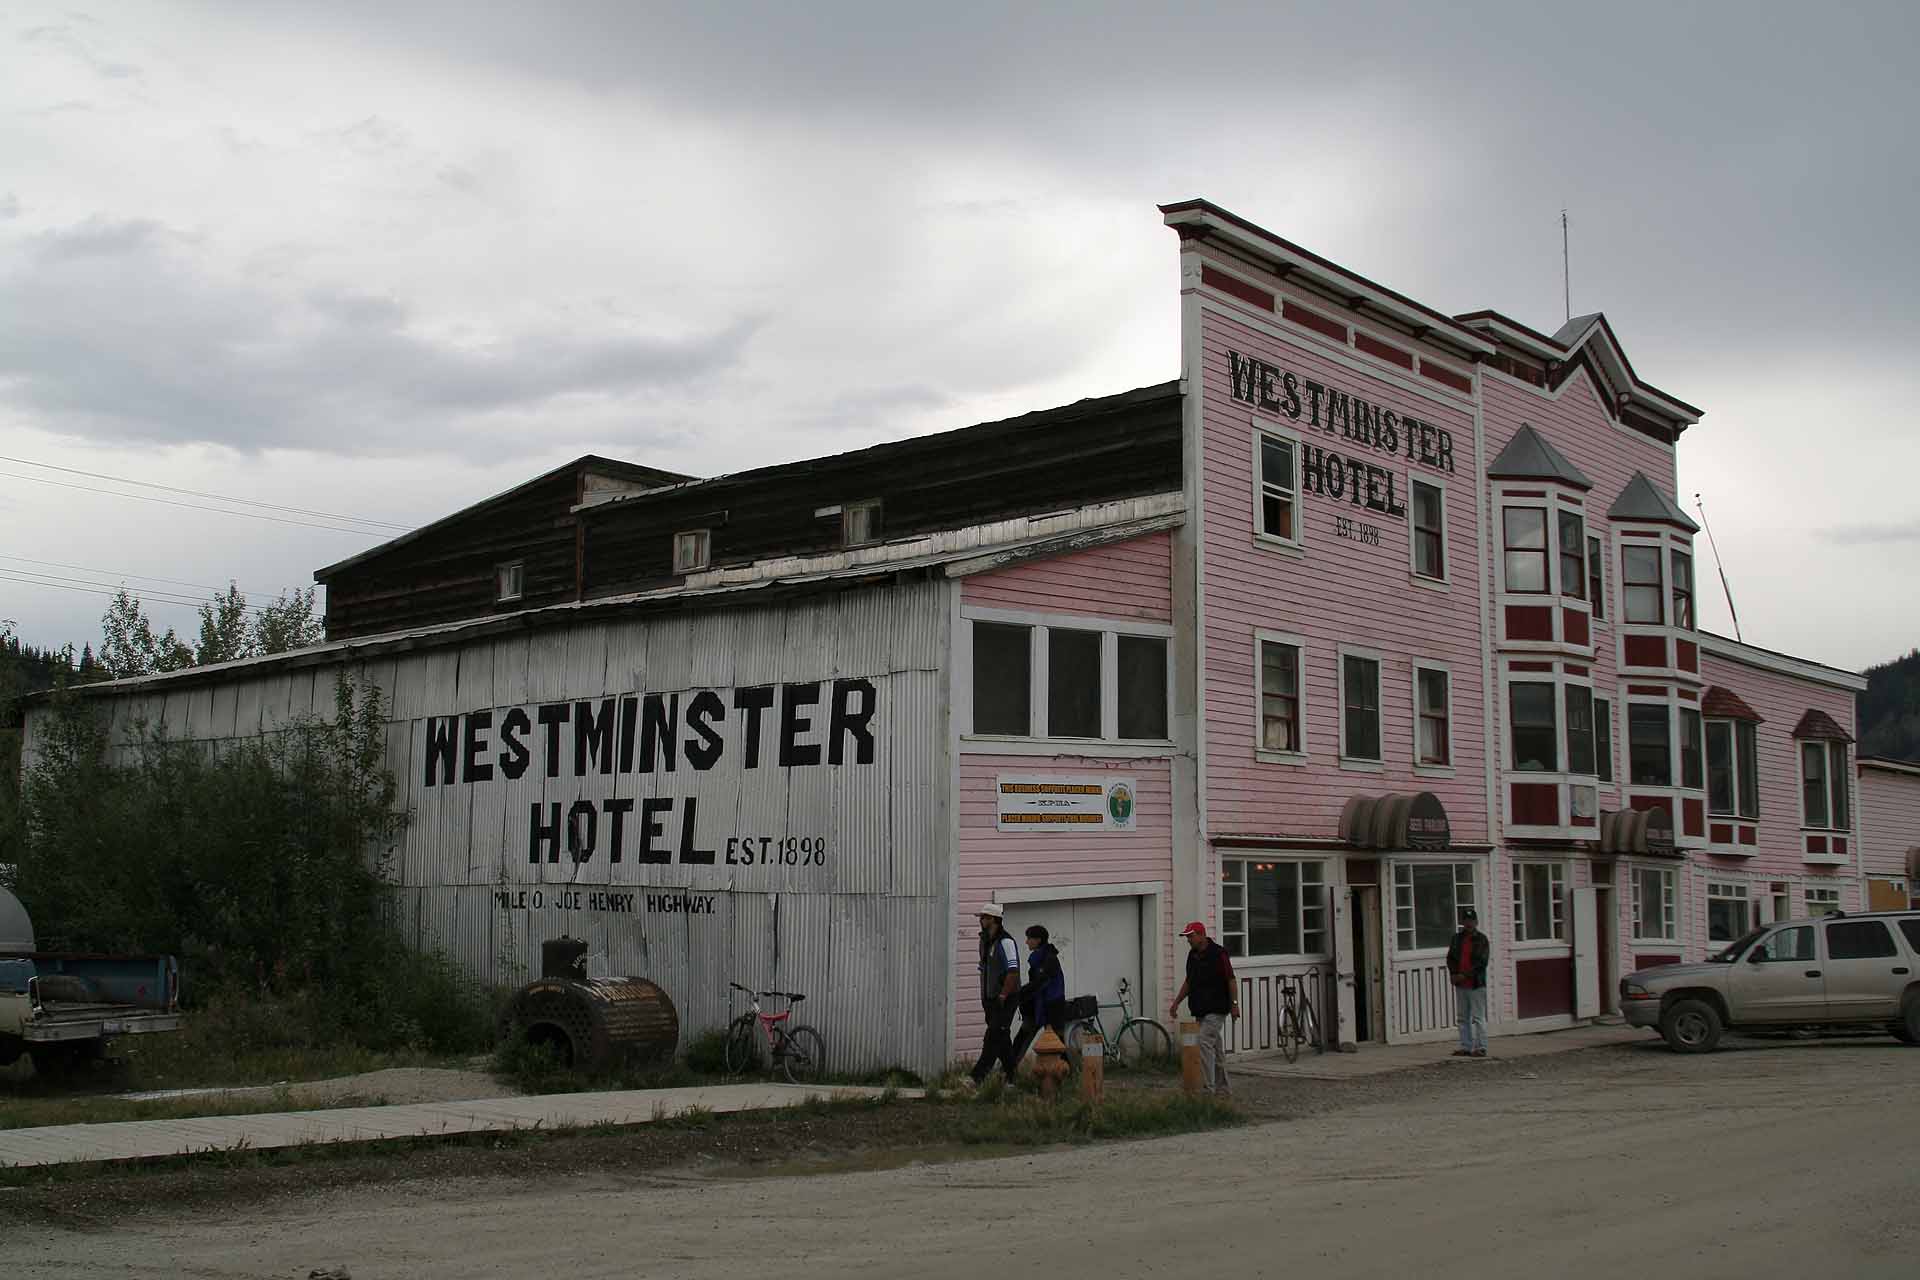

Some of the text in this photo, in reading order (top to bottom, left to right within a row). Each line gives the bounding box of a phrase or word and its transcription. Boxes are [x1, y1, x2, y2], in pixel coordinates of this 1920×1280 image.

[1226, 349, 1456, 475] WESTMINSTER
[1302, 443, 1406, 519] HOTEL
[1360, 523, 1379, 546] 1898
[424, 678, 876, 787] WESTMINSTER
[529, 797, 715, 865] HOTEL
[494, 890, 527, 910] MILE
[555, 891, 581, 911] JOE
[589, 892, 634, 913] HENRY
[648, 894, 716, 915] HIGHWAY.
